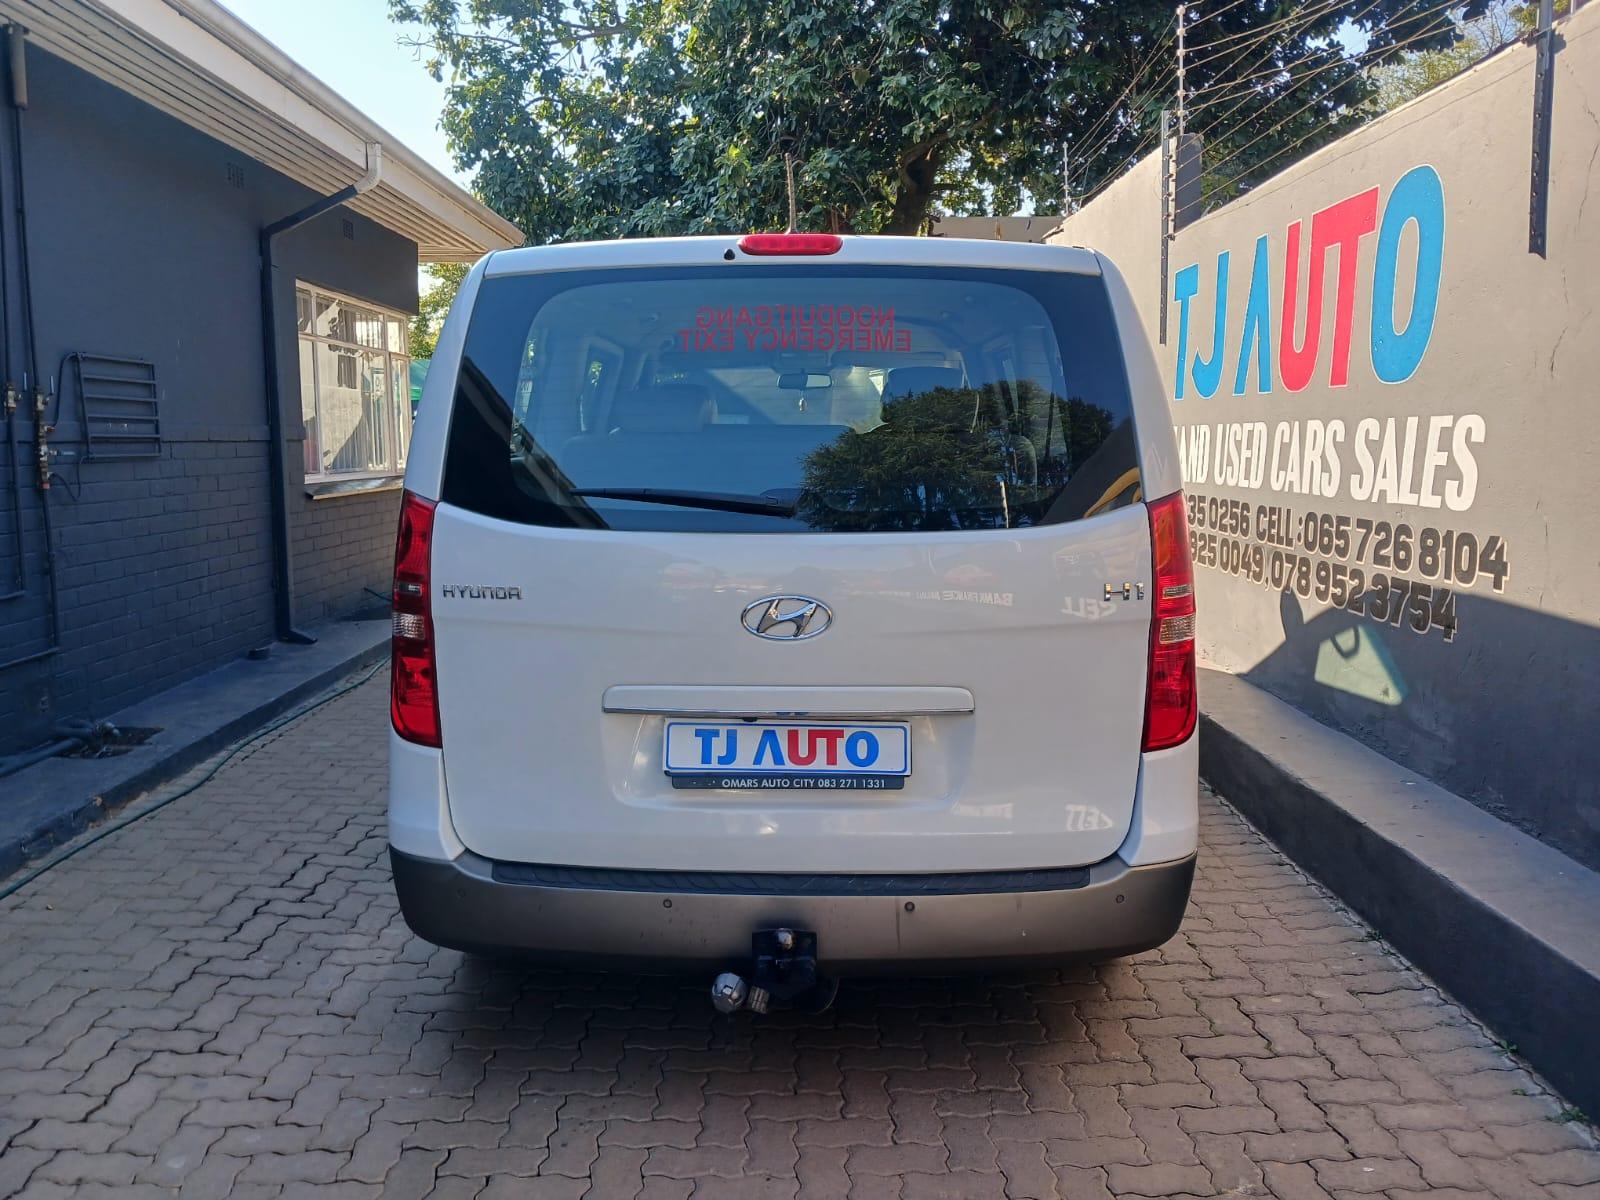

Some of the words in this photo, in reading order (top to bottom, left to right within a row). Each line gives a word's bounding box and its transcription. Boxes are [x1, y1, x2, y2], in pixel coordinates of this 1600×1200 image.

[1174, 249, 1231, 400] TJ
[1232, 163, 1446, 396] AUTO
[1214, 421, 1268, 490] USED
[1270, 419, 1346, 498] CARS
[1350, 414, 1486, 511] SALES
[1186, 494, 1207, 529] 35
[1208, 496, 1251, 540] 0256
[1356, 518, 1415, 574] 726
[1418, 527, 1511, 594] 8104
[1315, 560, 1366, 617] 952
[1370, 573, 1458, 643] 3754
[694, 728, 738, 766] TJ
[752, 729, 880, 767] AUTO
[721, 778, 758, 788] OMARS
[761, 778, 790, 788] AUTO
[793, 778, 815, 789] CITY
[818, 778, 837, 789] 083
[840, 778, 857, 789] 271
[862, 778, 885, 789] 1331
